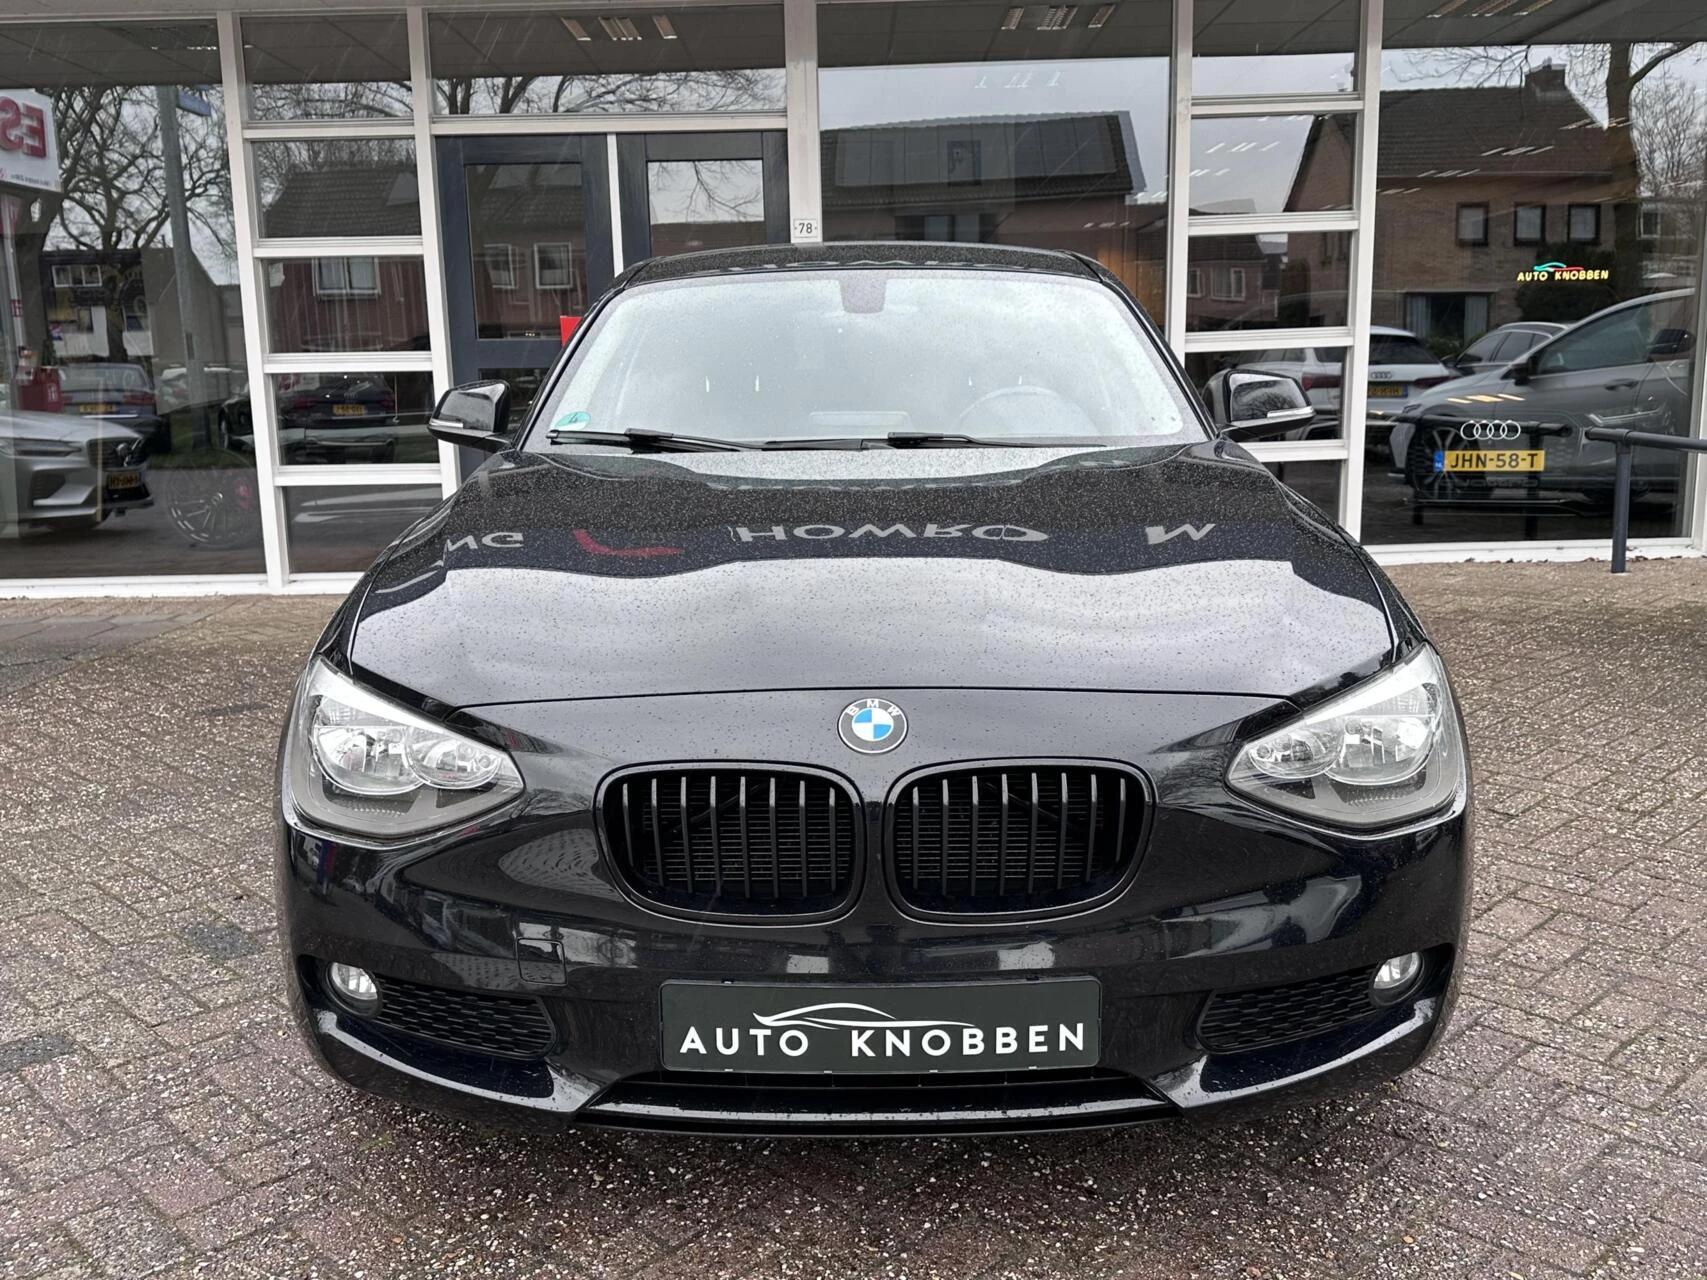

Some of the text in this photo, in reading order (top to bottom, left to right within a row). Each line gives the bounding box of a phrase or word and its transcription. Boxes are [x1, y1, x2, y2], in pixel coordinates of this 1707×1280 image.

[799, 222, 813, 234] 78
[1517, 269, 1609, 281] AUTO KNOBBEN
[1450, 453, 1538, 469] JHN-58-T
[846, 699, 901, 717] BMW
[680, 1023, 1085, 1057] AUTO KNOBBEN
